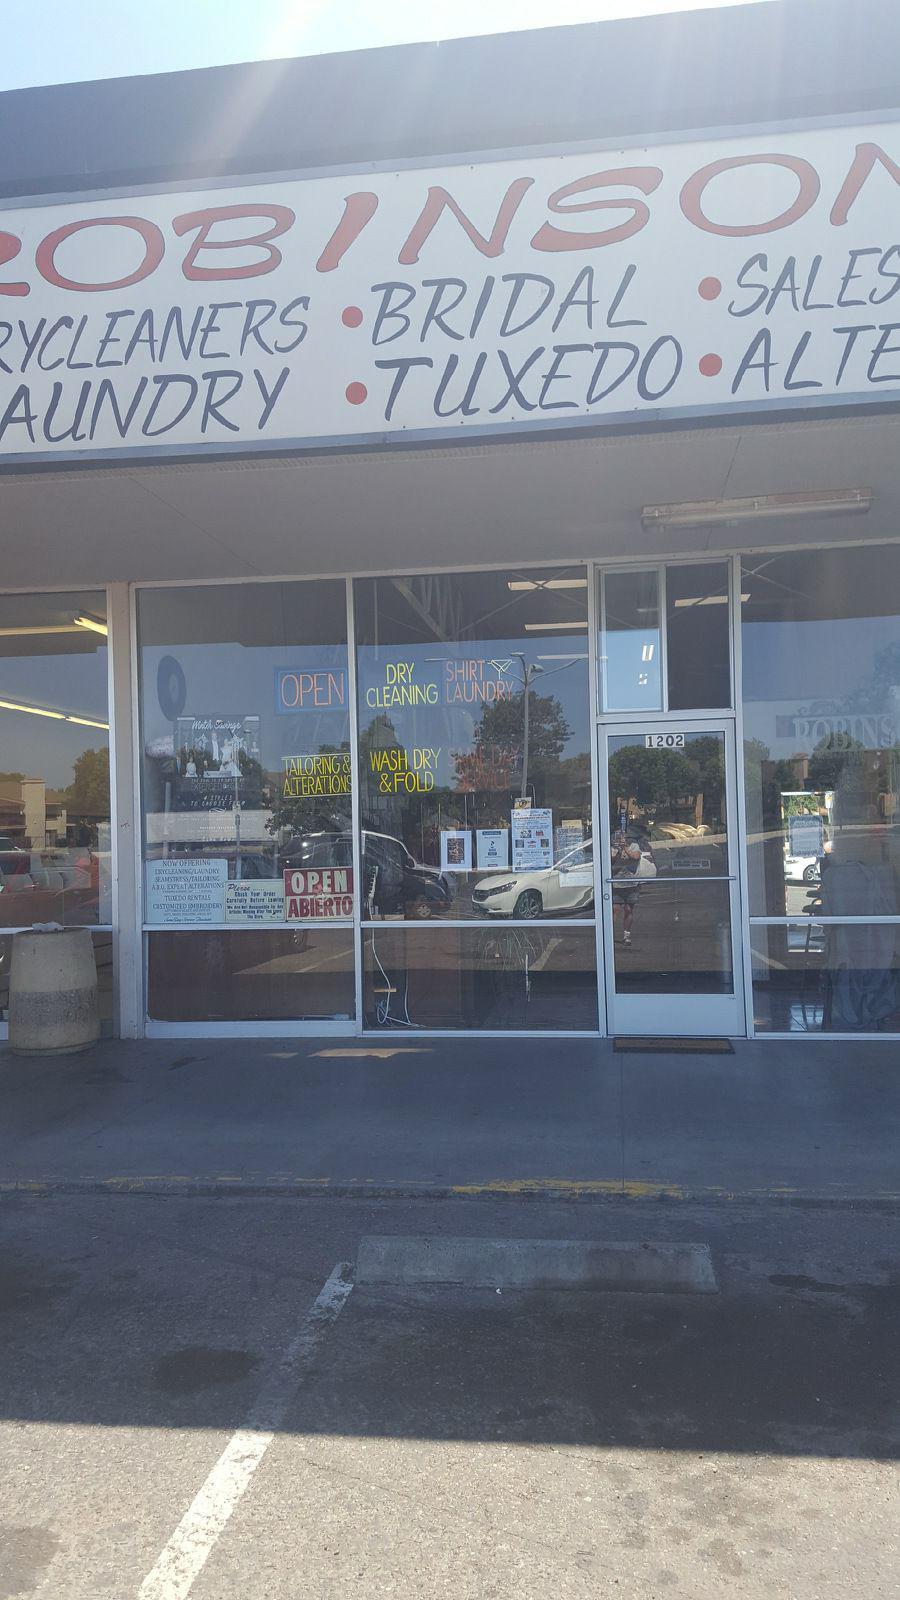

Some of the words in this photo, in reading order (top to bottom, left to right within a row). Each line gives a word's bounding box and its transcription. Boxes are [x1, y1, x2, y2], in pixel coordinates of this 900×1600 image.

[728, 245, 900, 316] SALES
[371, 264, 647, 345] BRIDAL
[732, 323, 900, 394] ALTE
[375, 335, 683, 421] TUXEDO
[0, 367, 290, 442] AUNDRY
[386, 662, 415, 685] DRY
[446, 659, 485, 682] SHIRT
[281, 671, 344, 707] OPEN
[366, 684, 438, 707] CLEANING
[446, 680, 514, 703] LAUNDRY
[647, 735, 684, 748] 1202
[281, 756, 340, 776] TAILORING
[342, 755, 351, 774] &
[370, 750, 407, 772] WASH
[413, 748, 441, 770] DRY
[283, 775, 352, 796] ALTERATIONS
[291, 870, 347, 894] OPEN
[288, 896, 353, 918] ABIERTO
